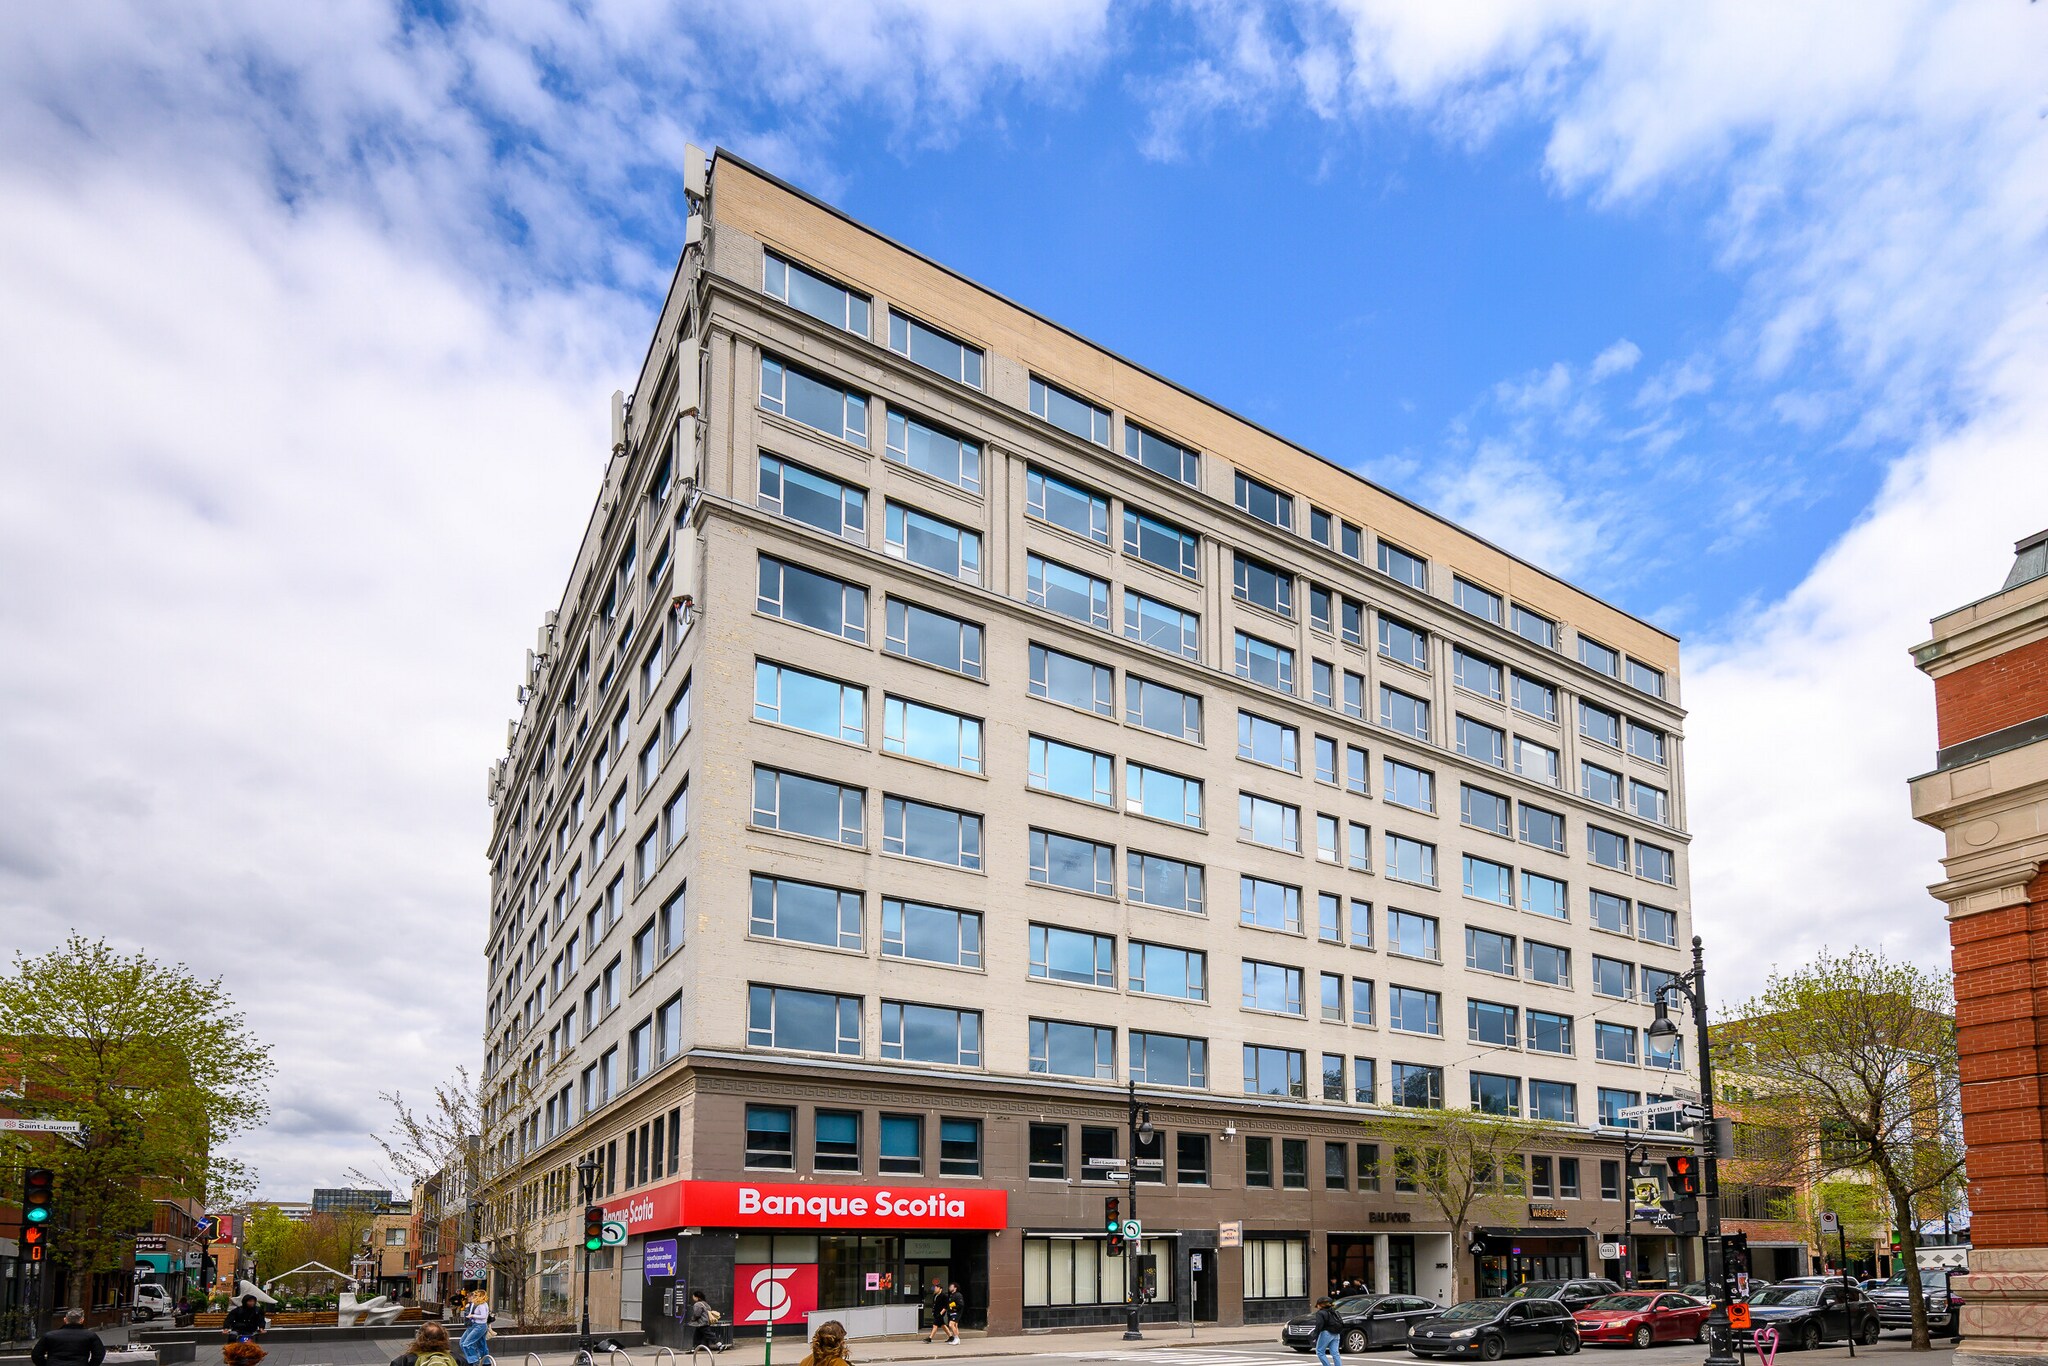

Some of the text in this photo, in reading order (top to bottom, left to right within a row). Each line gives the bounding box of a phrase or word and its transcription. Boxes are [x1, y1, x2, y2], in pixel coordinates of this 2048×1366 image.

[1621, 1106, 1672, 1117] Prince-Arthur
[18, 1123, 76, 1131] Saint-Laurent
[629, 1196, 654, 1224] Scotia
[738, 1188, 965, 1223] Banque Scotia
[1532, 1209, 1568, 1218] WAREHOUSE
